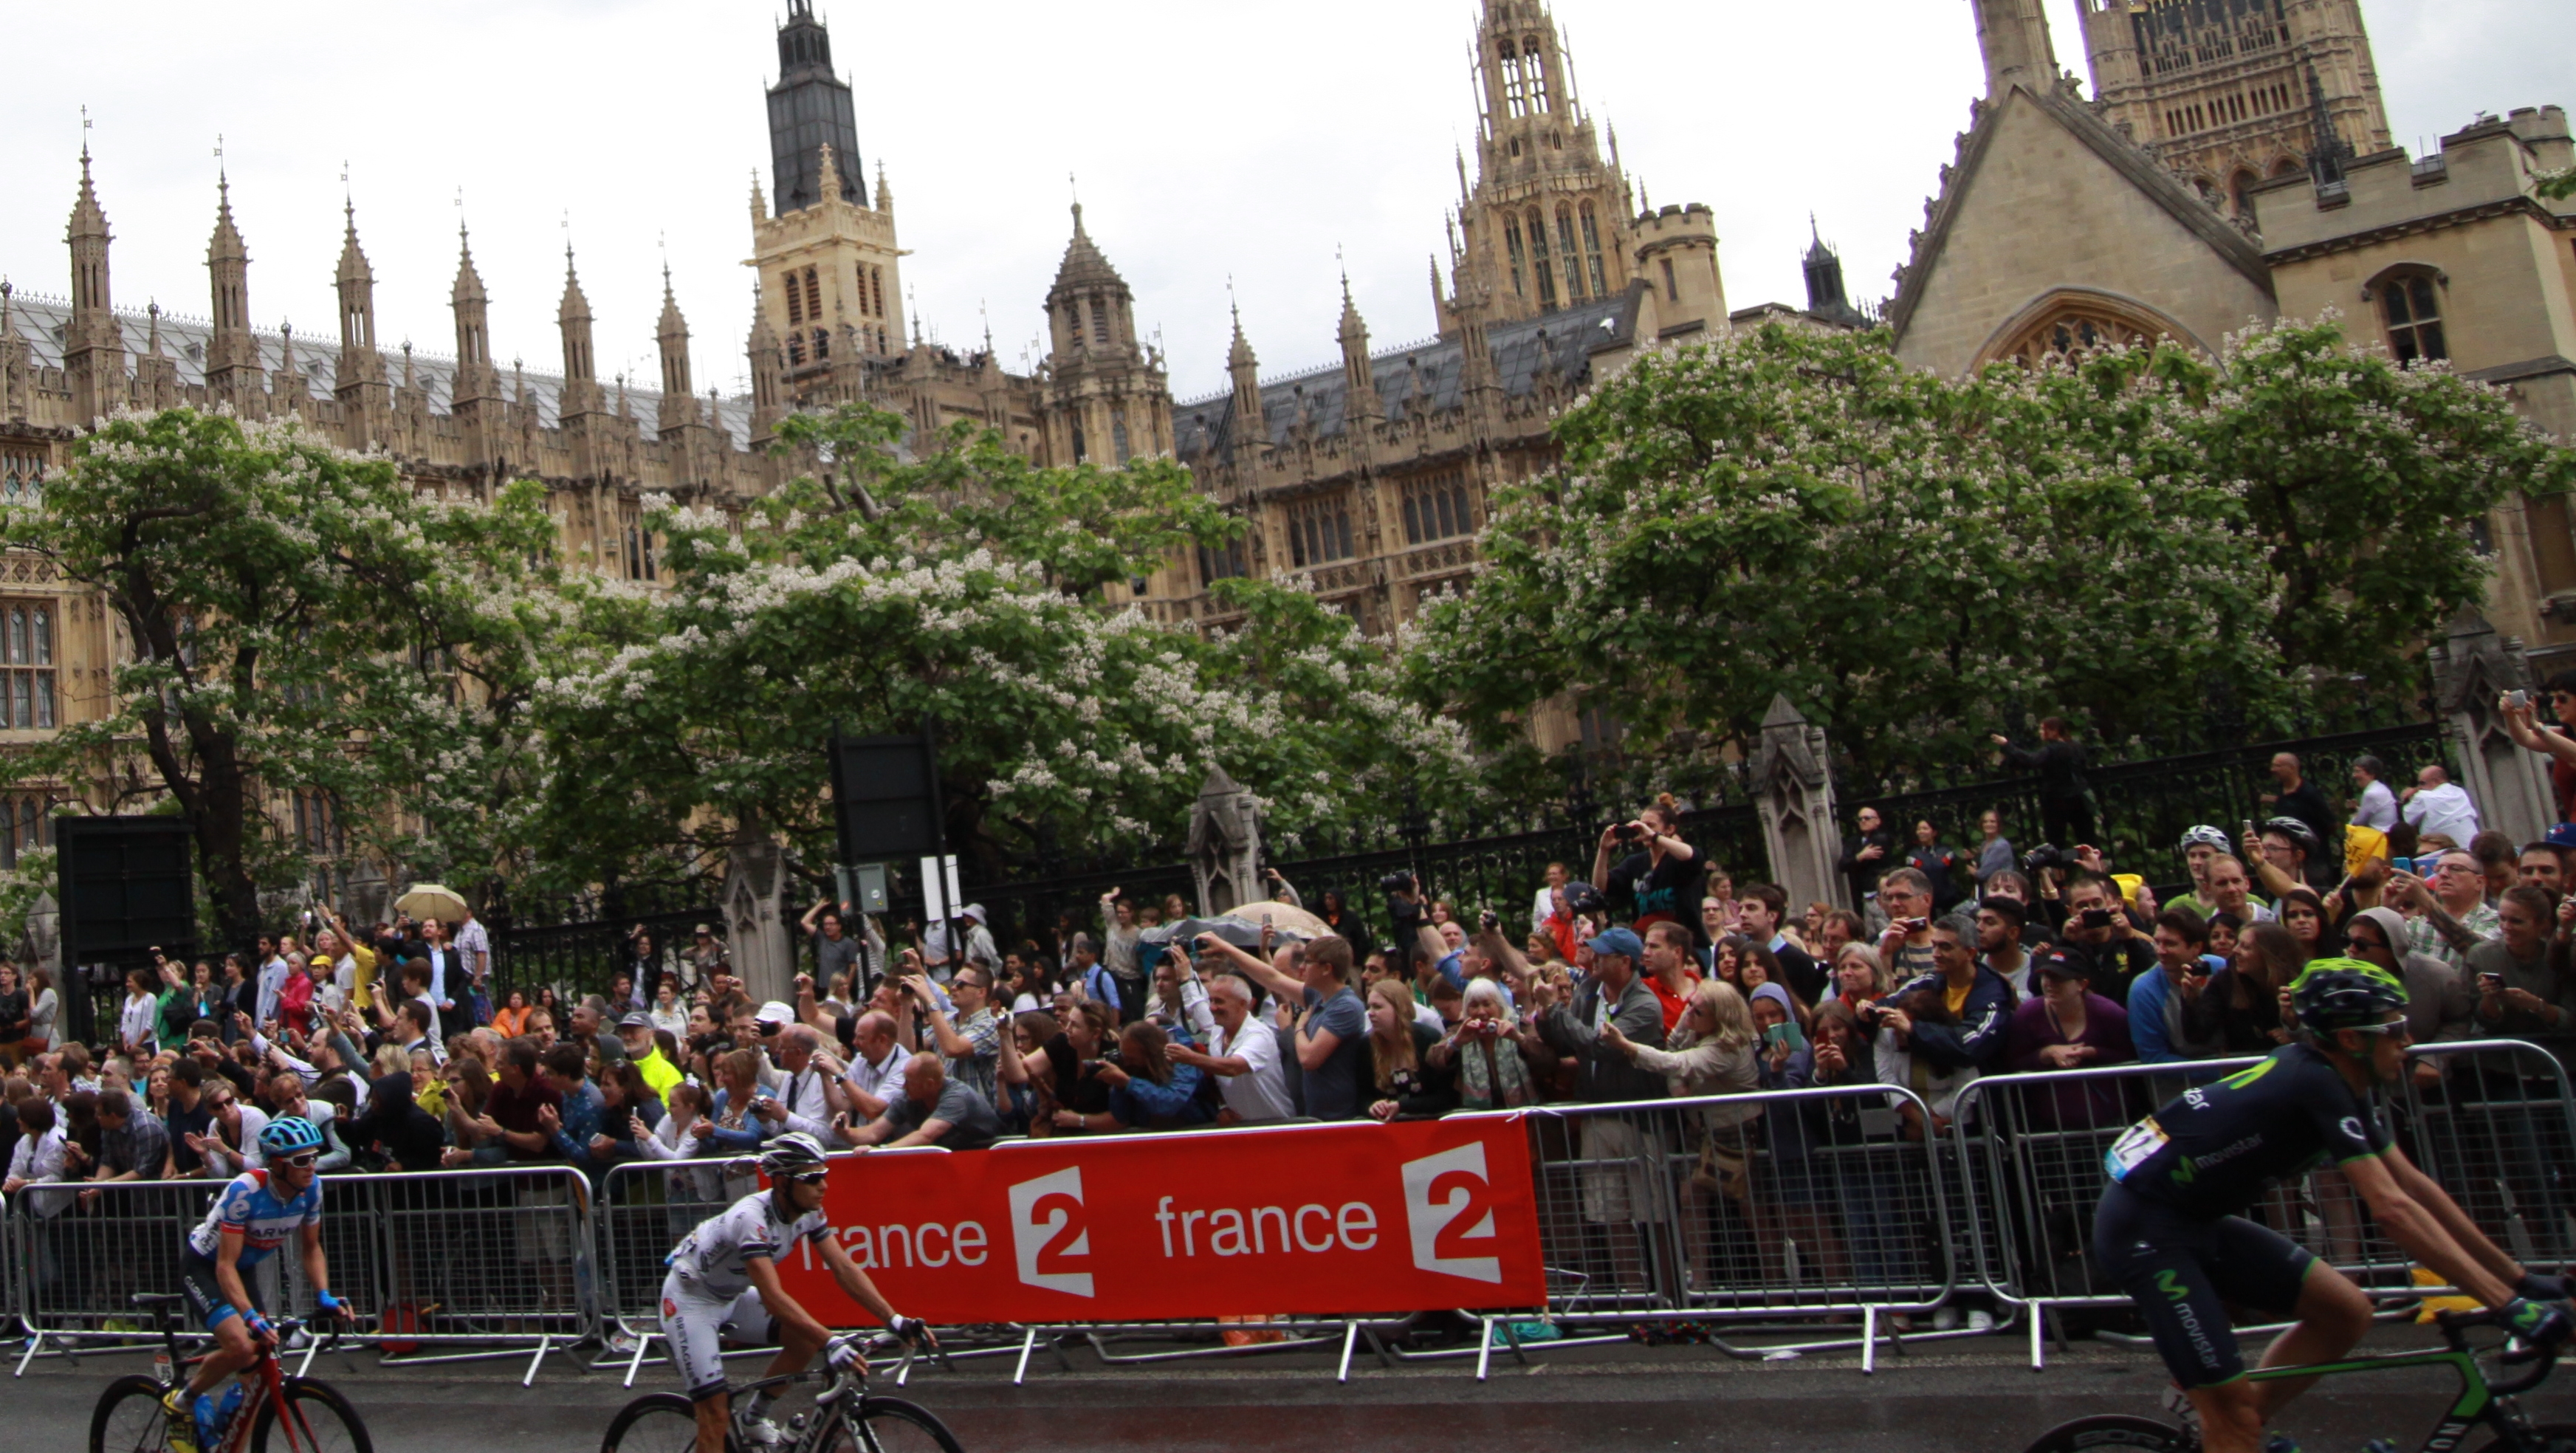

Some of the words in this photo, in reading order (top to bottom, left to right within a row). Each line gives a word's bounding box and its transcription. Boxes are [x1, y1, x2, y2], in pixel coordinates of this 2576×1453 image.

[2194, 1133, 2264, 1169] movistar
[1031, 1192, 1093, 1276] 2
[1155, 1195, 1378, 1257] france
[1426, 1169, 1499, 1260] 2
[2174, 1302, 2221, 1369] movistar
